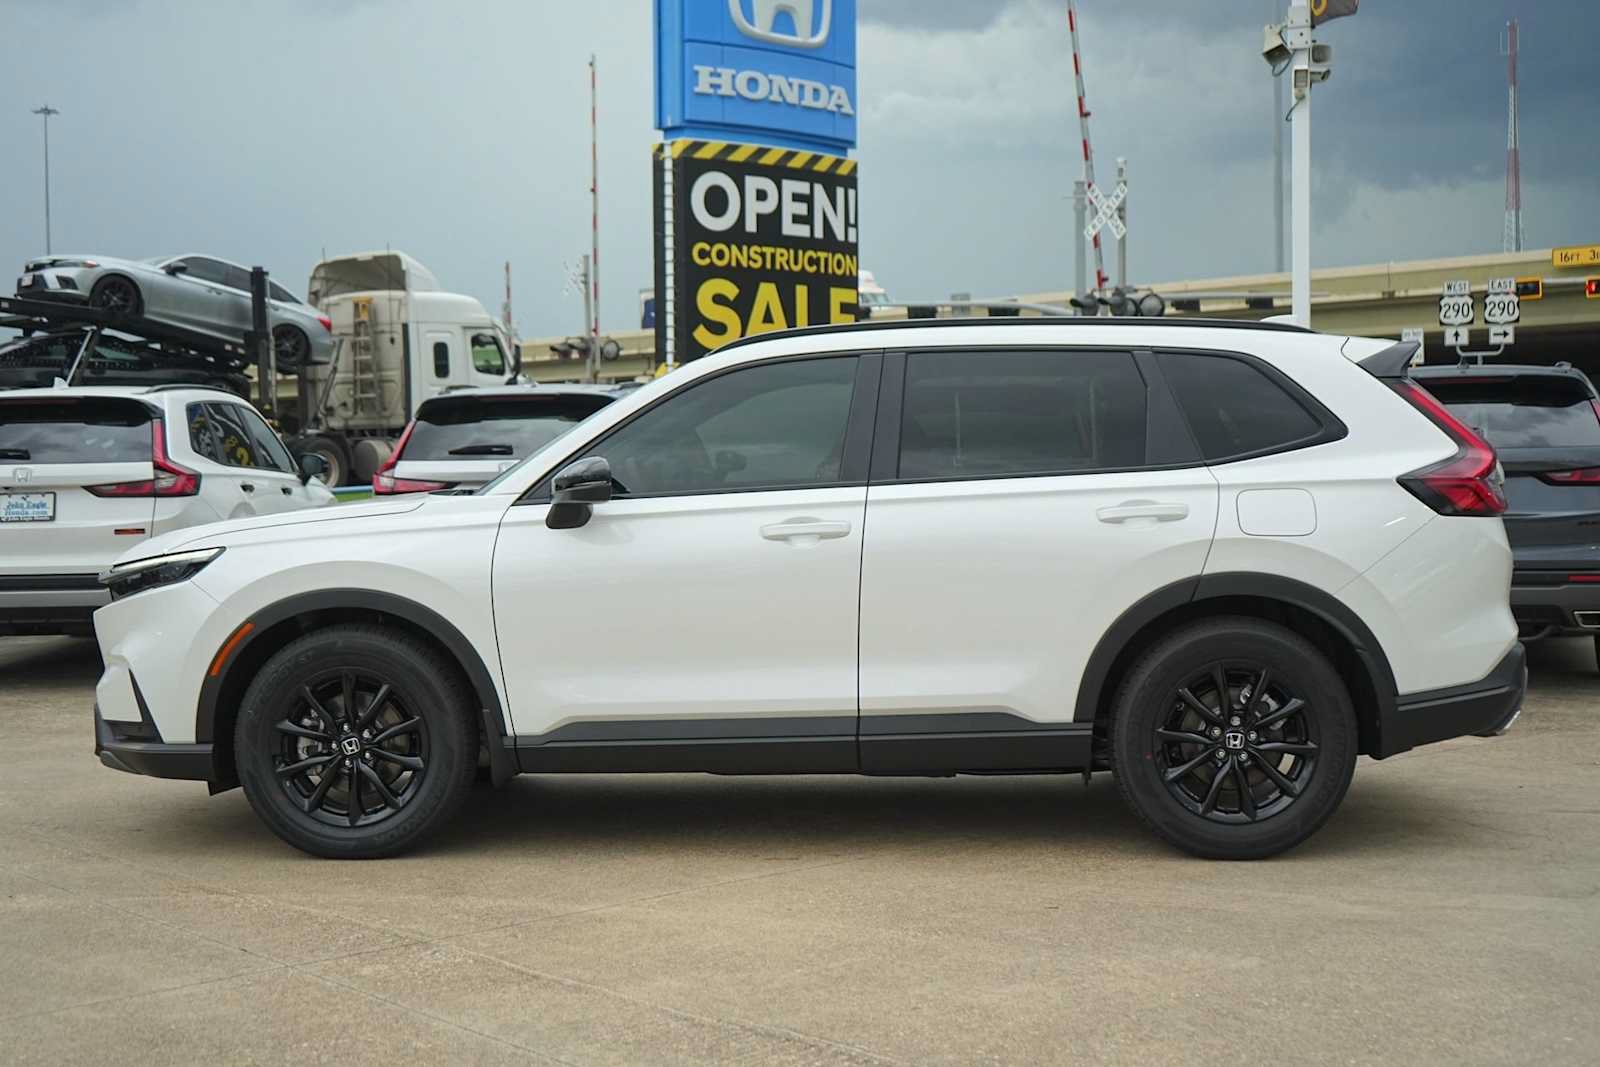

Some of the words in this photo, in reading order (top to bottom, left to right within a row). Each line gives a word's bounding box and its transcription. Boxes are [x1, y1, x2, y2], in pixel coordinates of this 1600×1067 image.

[693, 64, 854, 116] HONDA
[690, 170, 857, 243] OPEN!
[692, 242, 857, 276] CONSTRUCTION
[1446, 281, 1467, 292] WEST
[1491, 279, 1513, 290] EAST
[692, 277, 858, 351] SALE
[1443, 303, 1470, 319] 290
[1488, 300, 1516, 317] 290
